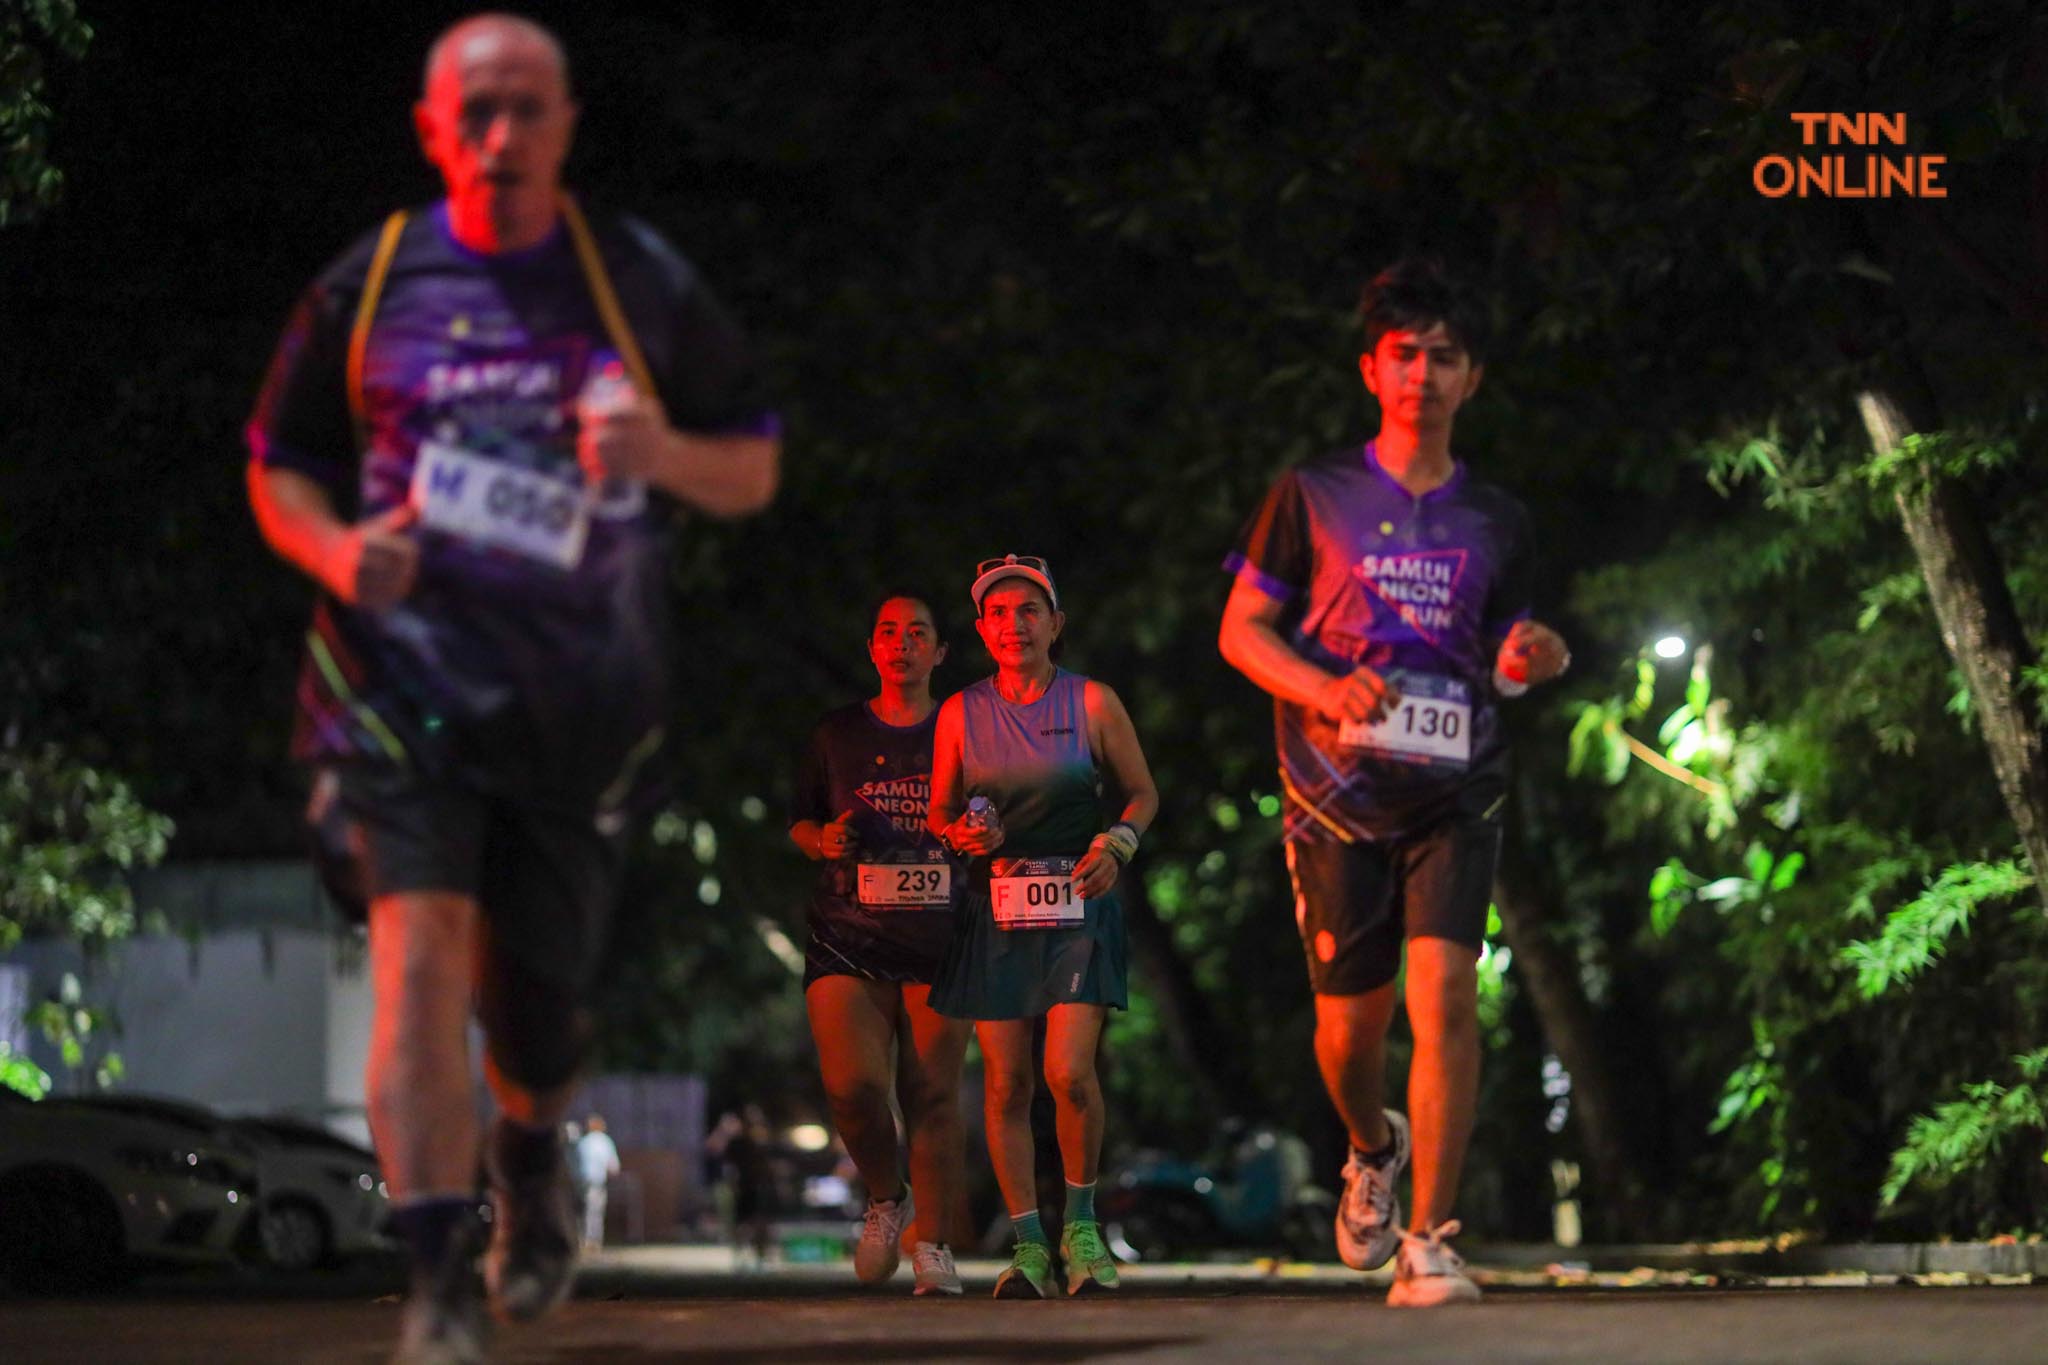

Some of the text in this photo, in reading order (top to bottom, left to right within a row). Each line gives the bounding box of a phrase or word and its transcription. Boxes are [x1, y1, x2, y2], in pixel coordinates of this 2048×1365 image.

[1362, 555, 1450, 583] SAMUI
[1378, 580, 1450, 605] NEON
[1401, 604, 1452, 630] RUN
[1403, 704, 1459, 739] 130
[862, 781, 929, 799] SAMUI
[875, 799, 929, 815] NEON
[928, 850, 944, 860] 5K
[1060, 860, 1076, 871] 5K
[863, 870, 941, 892] F 239
[997, 882, 1072, 908] F 001
